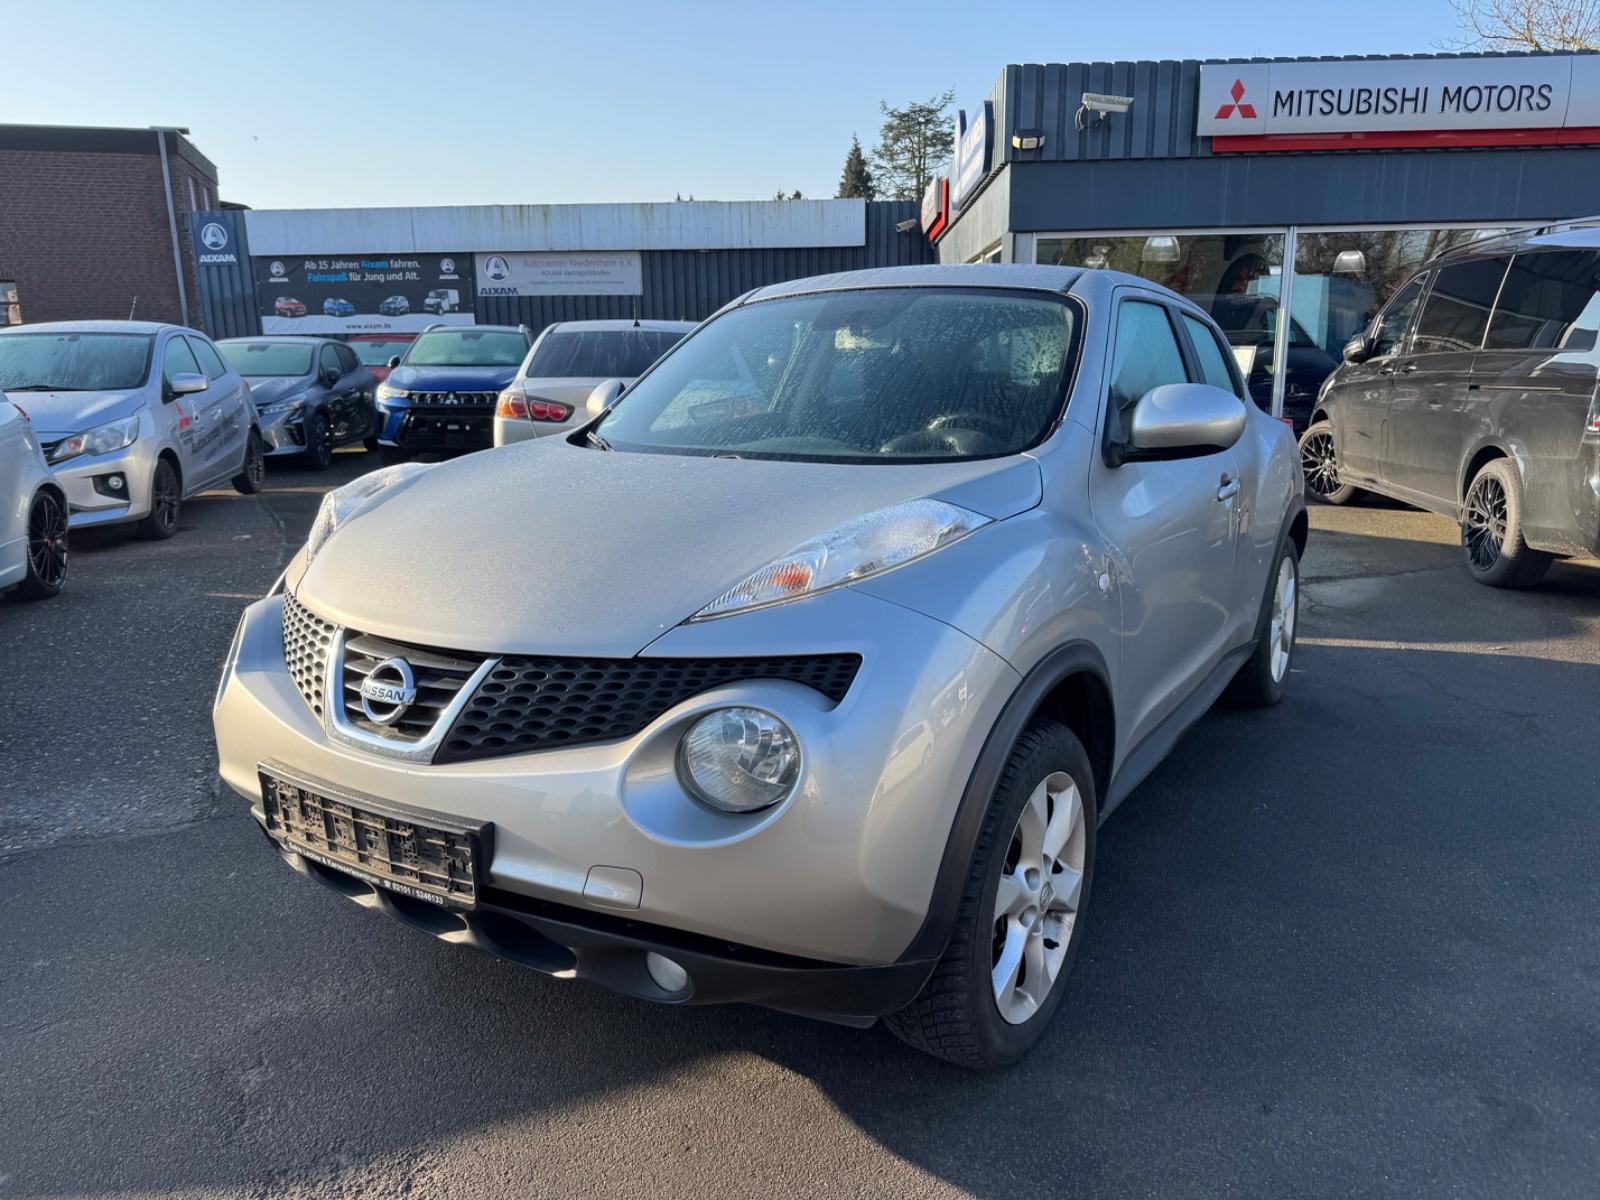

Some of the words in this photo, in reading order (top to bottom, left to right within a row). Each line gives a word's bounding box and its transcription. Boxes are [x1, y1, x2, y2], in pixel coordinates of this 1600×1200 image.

[1272, 86, 1428, 117] MITSUBISHI
[1440, 83, 1553, 112] MOTORS
[200, 254, 237, 263] AIXAM
[304, 261, 317, 270] Ab
[318, 261, 329, 269] 15
[330, 261, 360, 270] Jahren
[522, 259, 567, 268] Autocenter
[307, 272, 348, 283] Fahrspaß
[349, 272, 361, 281] für
[363, 273, 385, 283] Jung
[387, 272, 403, 281] und
[405, 271, 421, 280] Alt.
[480, 287, 519, 296] AIXAM
[361, 682, 406, 701] NISSAN
